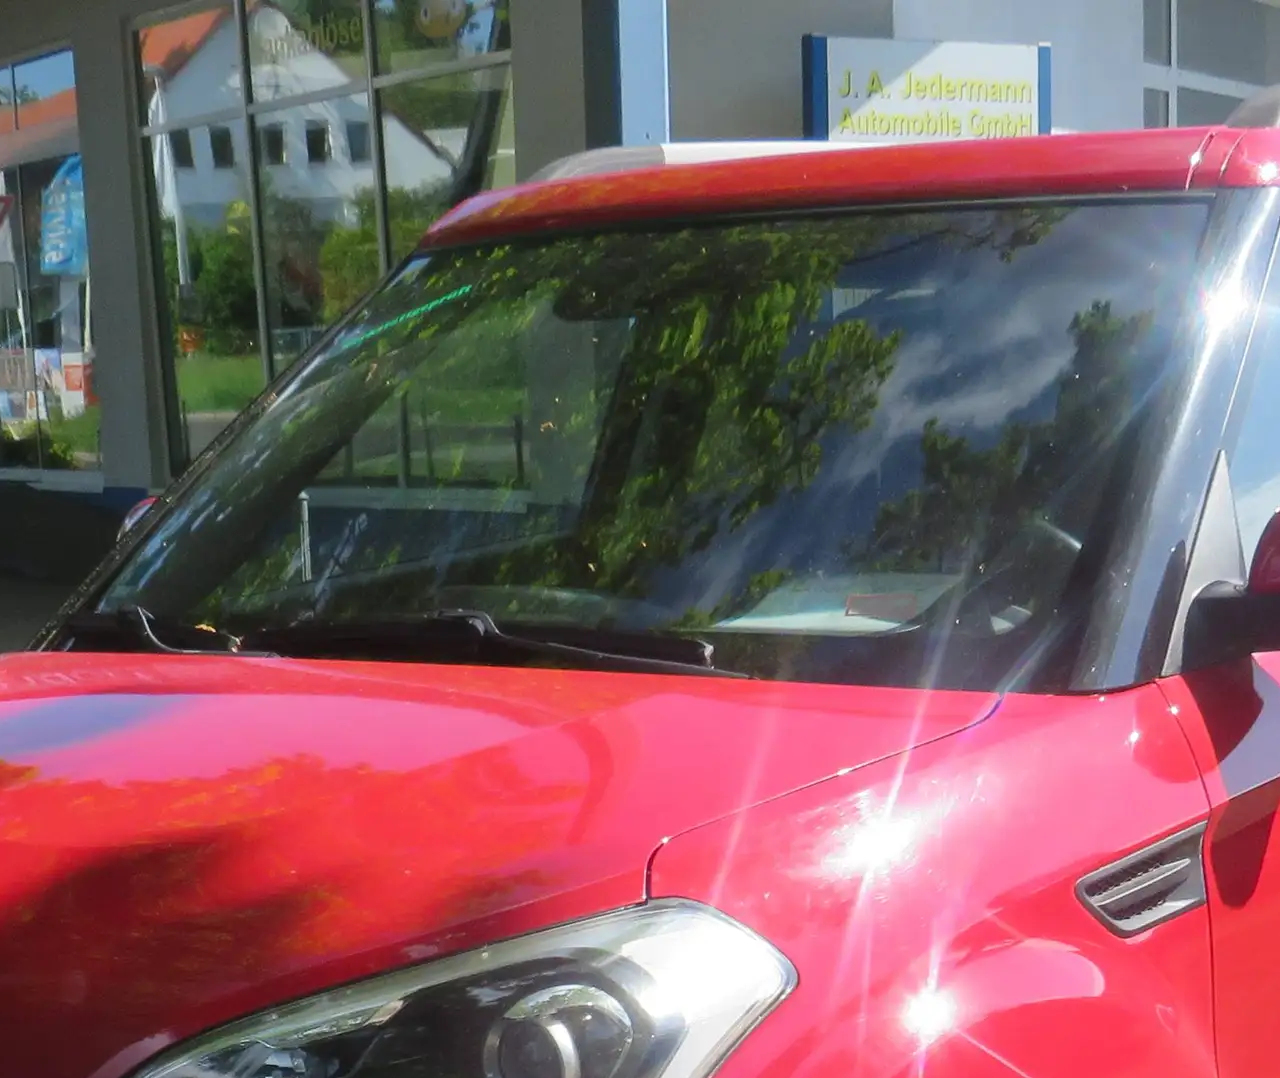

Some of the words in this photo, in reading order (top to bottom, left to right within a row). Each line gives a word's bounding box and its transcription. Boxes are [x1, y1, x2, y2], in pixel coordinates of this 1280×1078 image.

[839, 69, 859, 98] J.
[866, 70, 891, 99] A.
[902, 70, 1032, 103] Jedermann
[839, 106, 962, 136] Automobile
[969, 108, 1032, 140] GmbH
